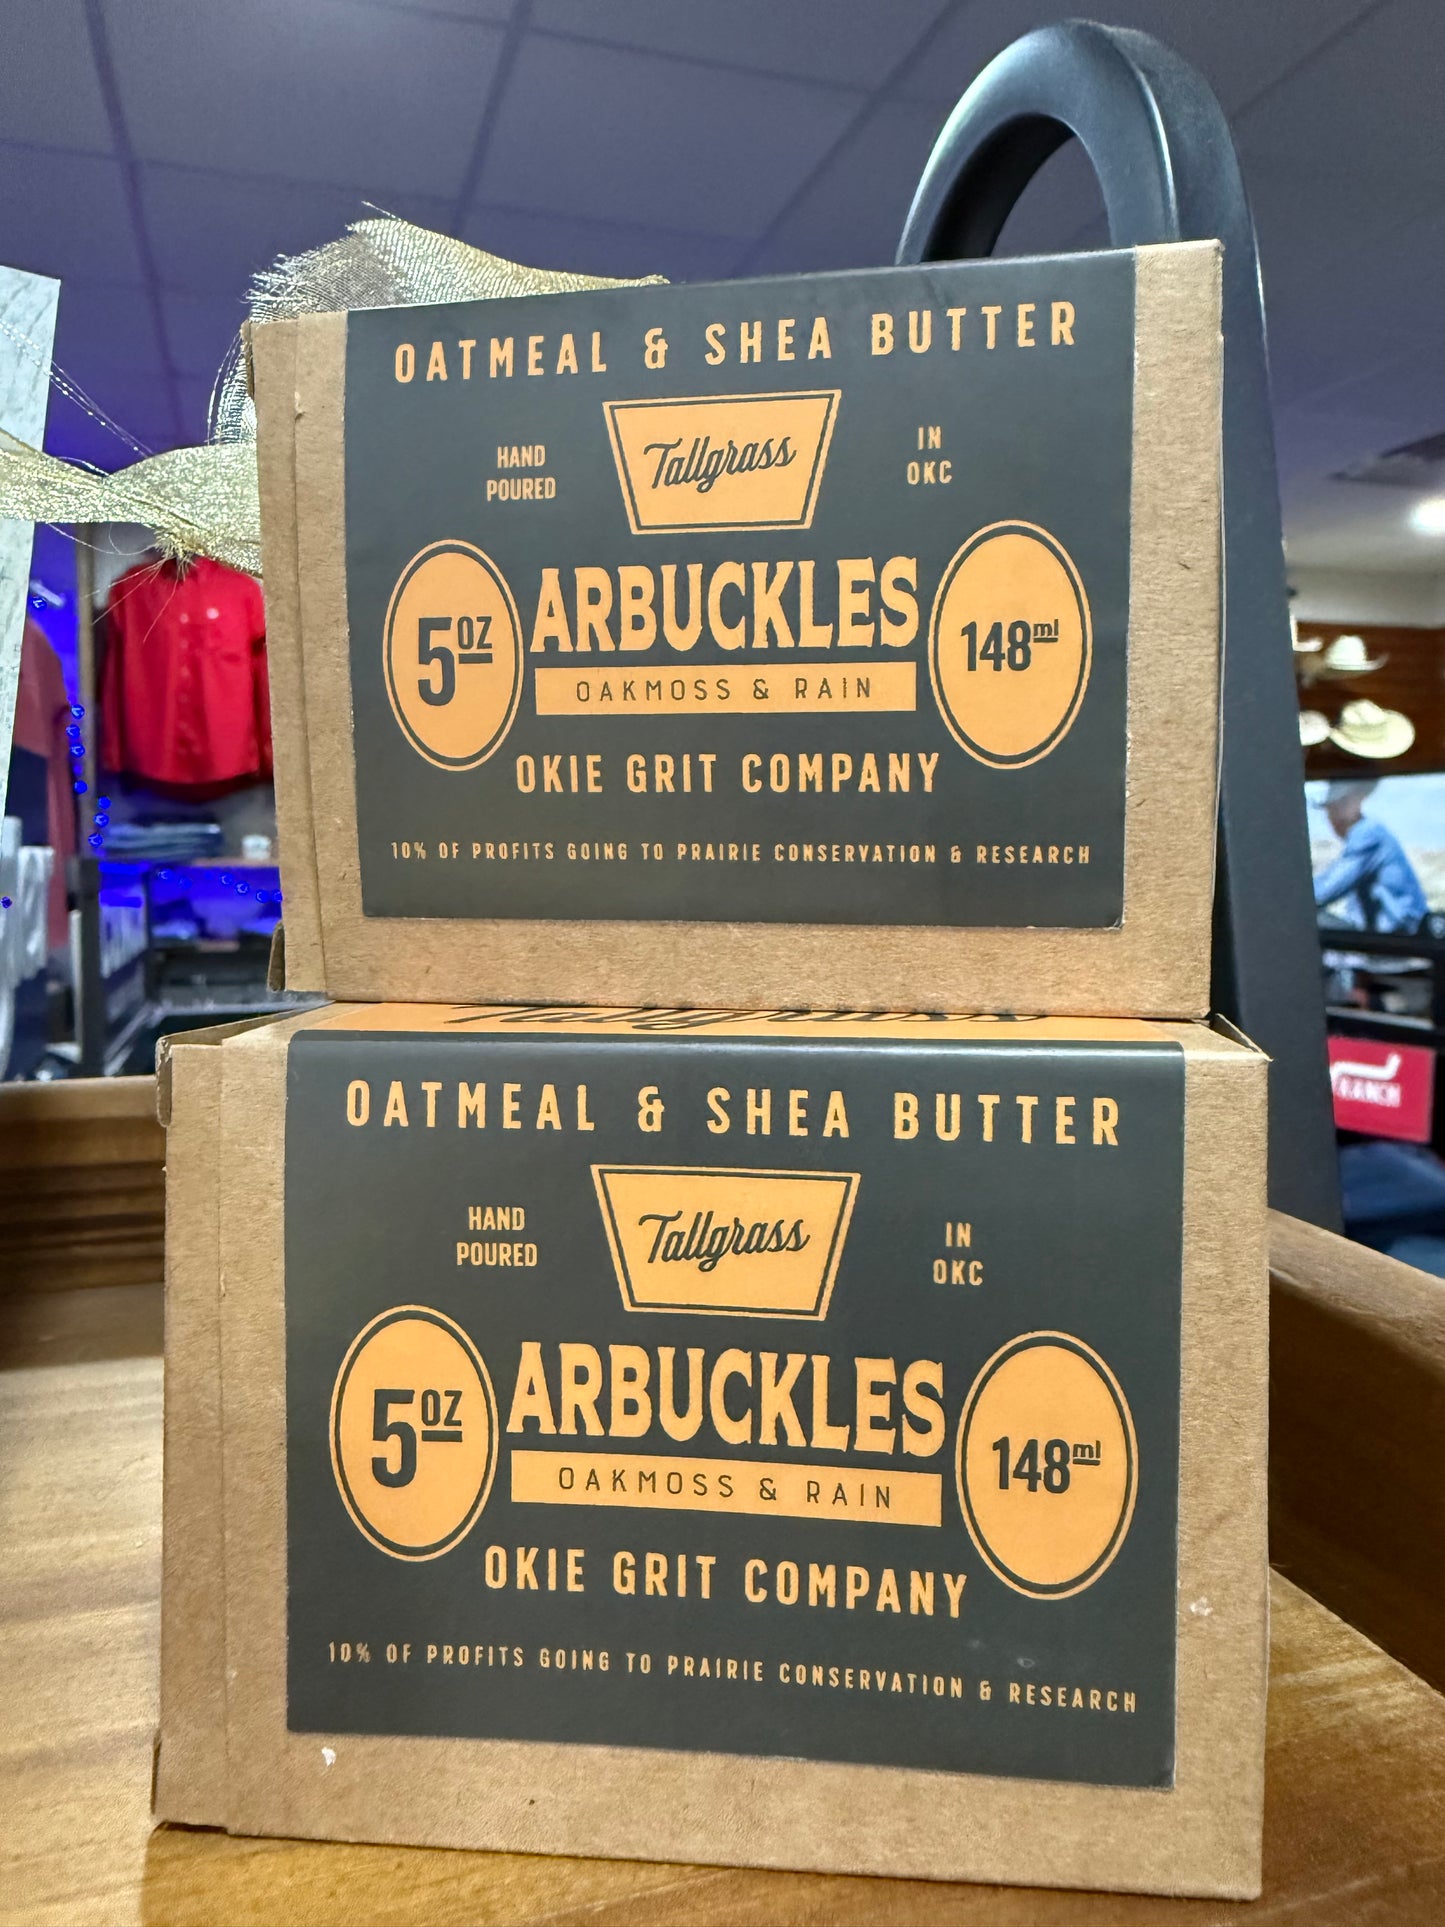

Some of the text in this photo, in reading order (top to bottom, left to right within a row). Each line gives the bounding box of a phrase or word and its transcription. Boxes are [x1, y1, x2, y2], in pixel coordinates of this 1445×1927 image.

[395, 302, 1074, 383] OATMEAL & SHEA BUTTER
[919, 426, 941, 449] IN
[498, 445, 545, 468] HAND
[644, 436, 796, 493] Tallgrass
[907, 461, 952, 485] OKC
[487, 477, 555, 501] POURED
[530, 556, 918, 652] ARBUCKLES
[577, 678, 870, 702] OAKMOSS & RAIN
[517, 753, 939, 793] OKIE GRIT COMPANY
[392, 842, 1089, 864] 10% OF PROFITS GOING TO PRAIRIE CONSERVATION & RESEARCH
[347, 1080, 1118, 1145] OATMEAL & SHEA BUTTER
[469, 1207, 524, 1230] HAND
[946, 1223, 970, 1247] IN
[457, 1242, 537, 1266] POURED
[639, 1211, 810, 1272] Tallgrass
[934, 1259, 983, 1285] OKC
[506, 1342, 945, 1457] ARBUCKLES
[559, 1467, 889, 1509] OAKMOSS & RAIN
[485, 1546, 967, 1618] OKIE GRIT COMPANY
[329, 1642, 1135, 1712] 10% OF PROFITS GOING TO PRAIRIE CONSERVATION & RESEARCH
